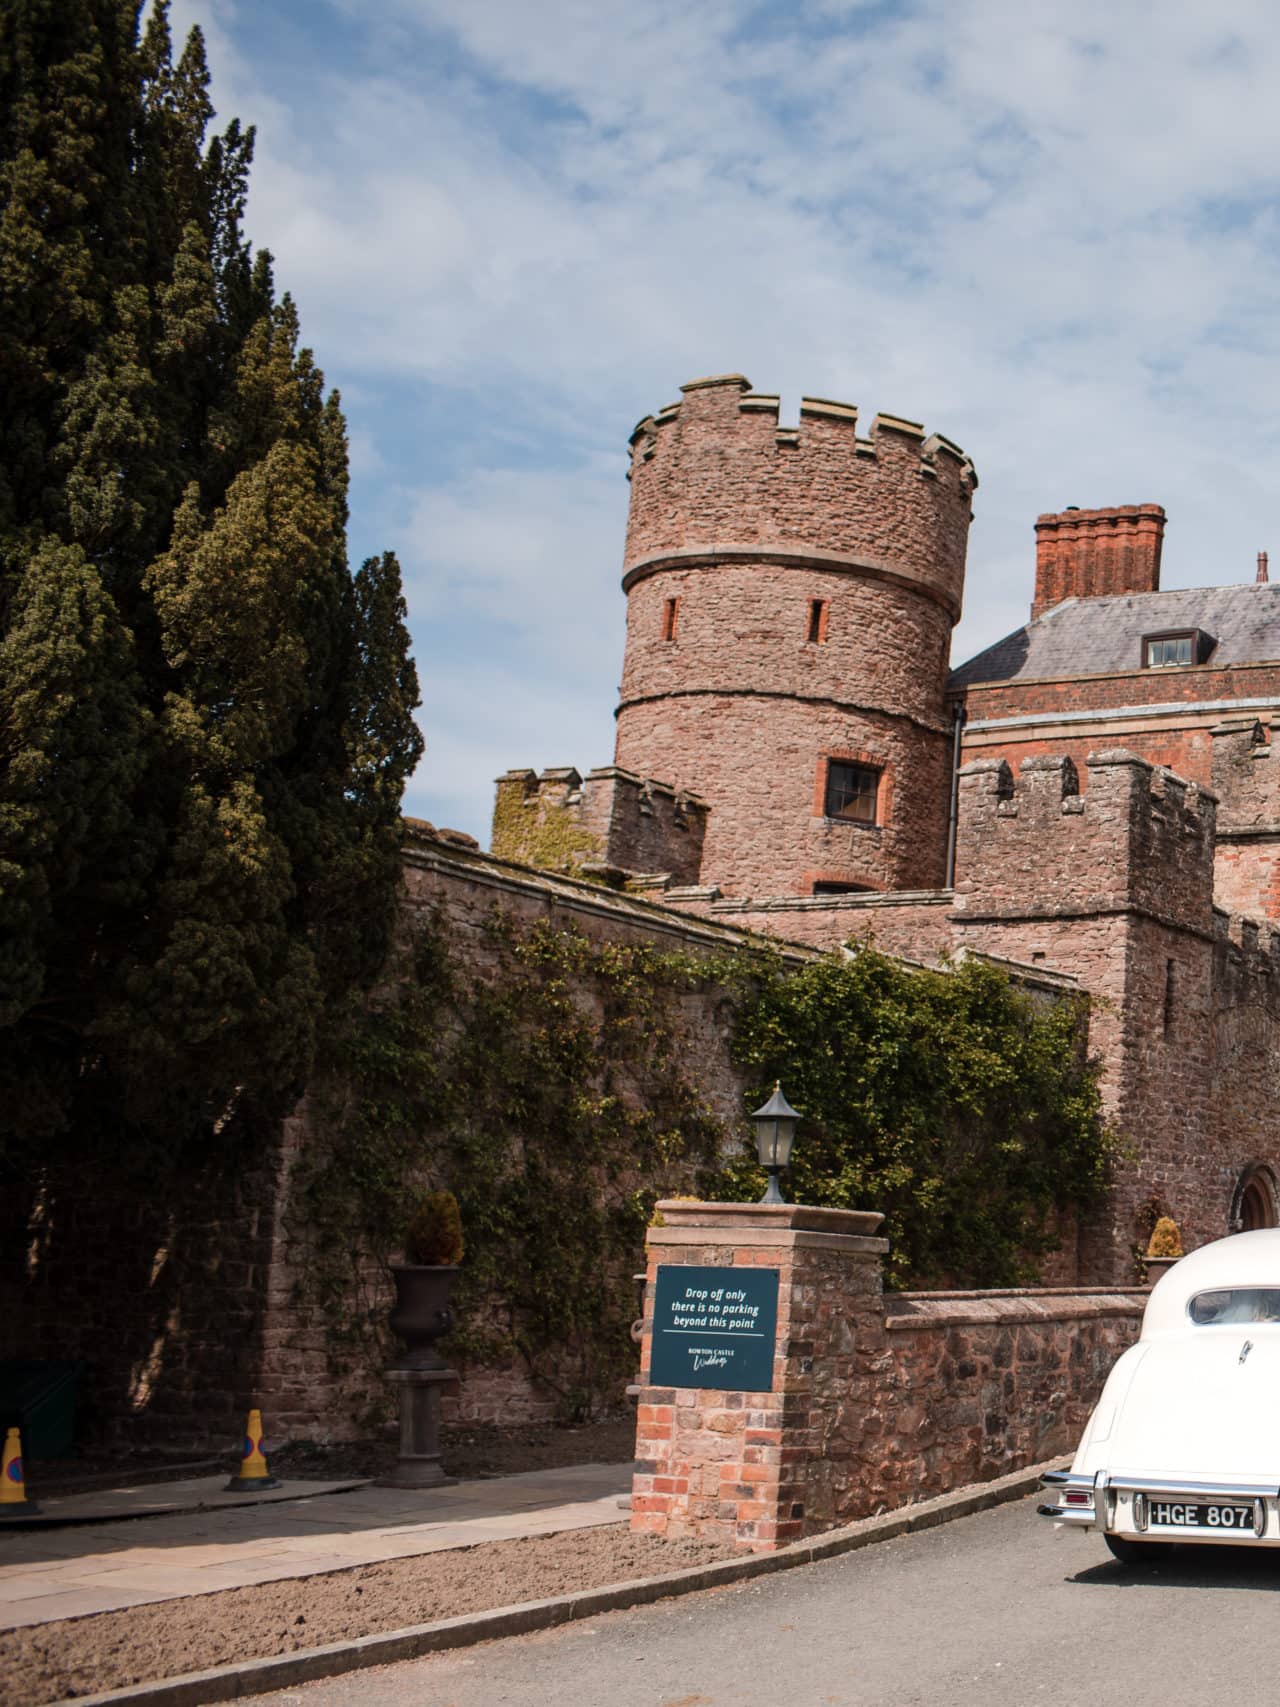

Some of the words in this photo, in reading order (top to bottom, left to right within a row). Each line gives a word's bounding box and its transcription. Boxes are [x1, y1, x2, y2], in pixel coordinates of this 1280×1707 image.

[686, 1288, 707, 1300] Drop
[710, 1289, 724, 1301] off
[726, 1290, 746, 1302] only
[671, 1301, 695, 1312] there
[698, 1303, 706, 1312] is
[708, 1305, 720, 1313] no
[722, 1304, 759, 1317] parking
[674, 1315, 707, 1328] beyond
[710, 1317, 726, 1327] this
[729, 1319, 754, 1330] point
[1157, 1504, 1199, 1525] HGE
[1207, 1506, 1249, 1527] 807
